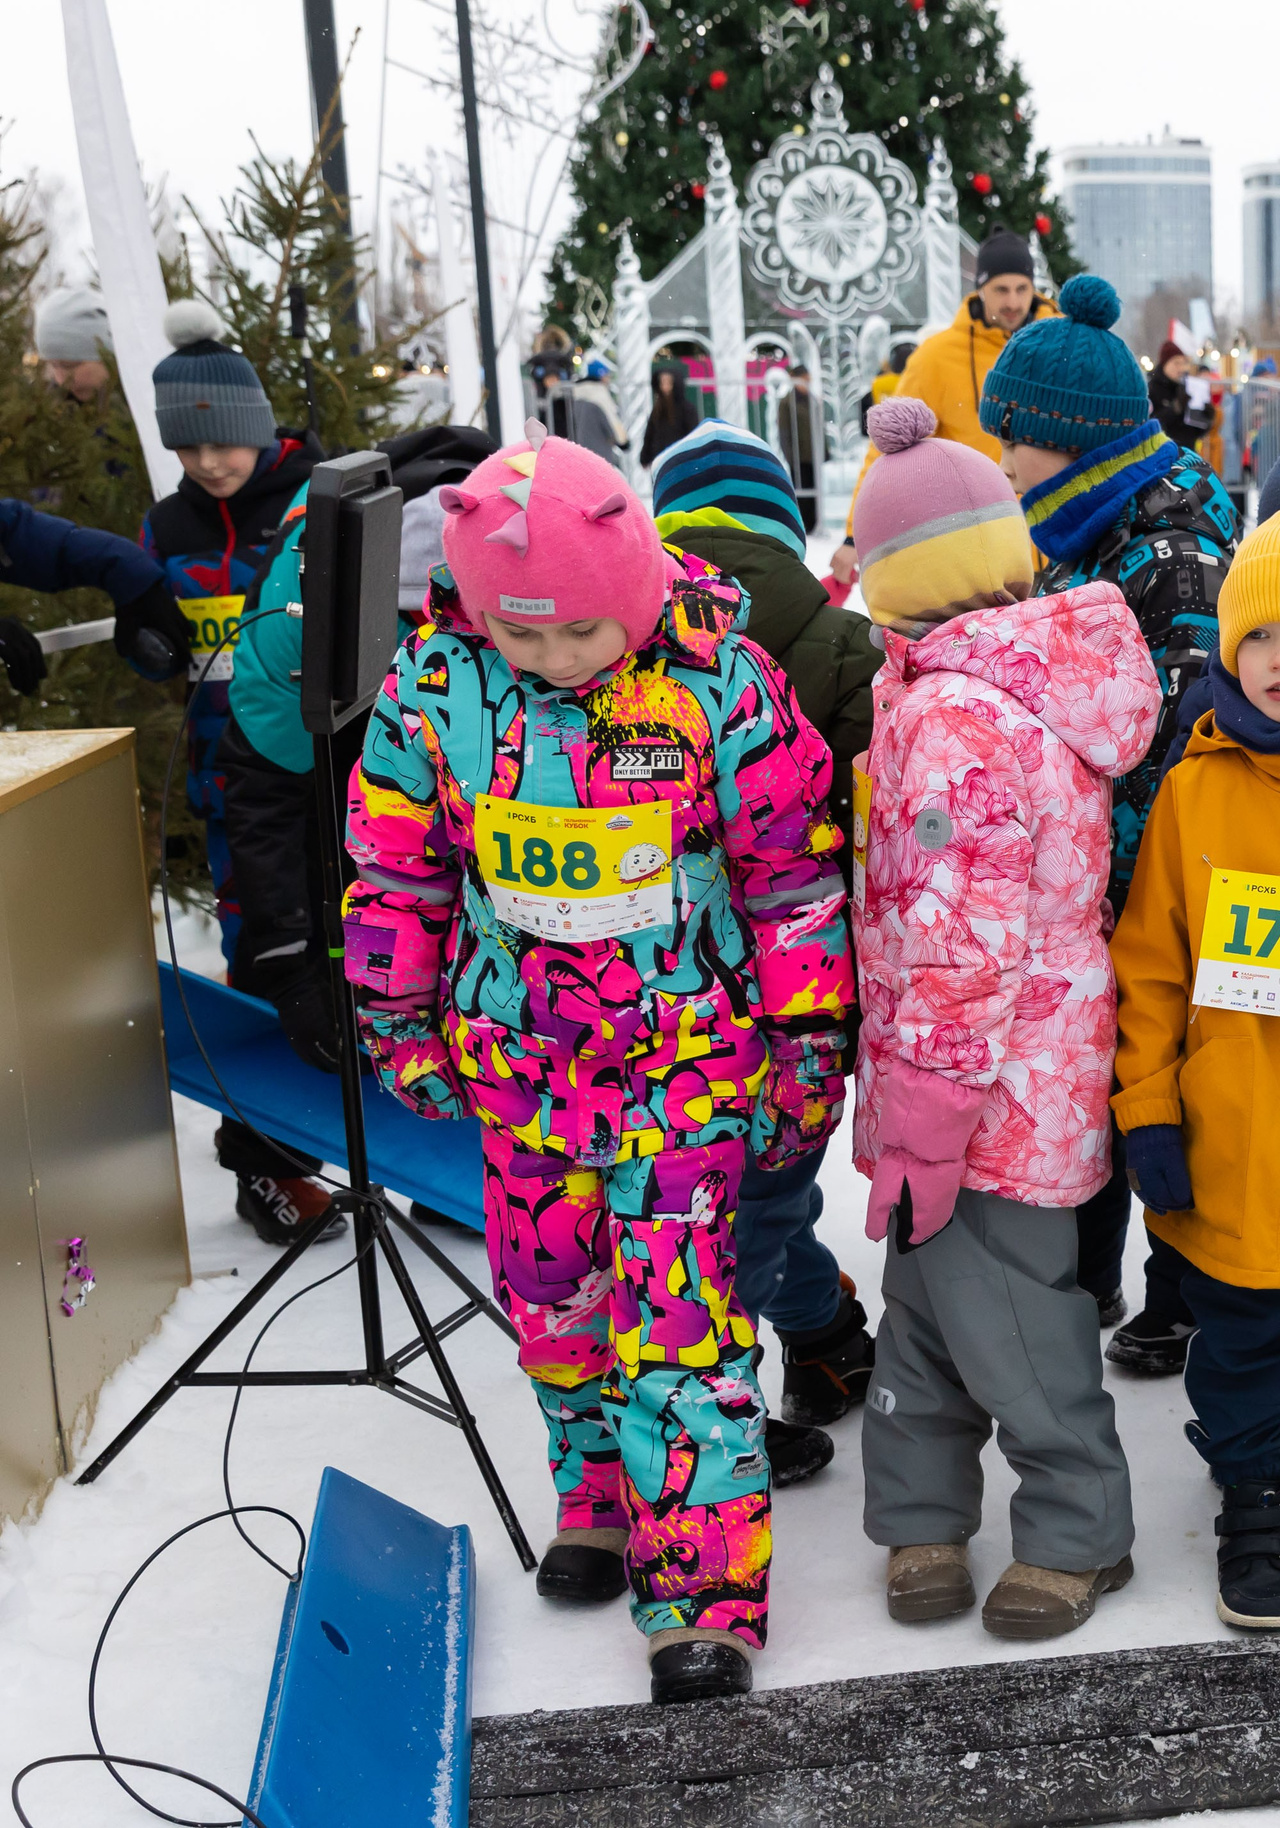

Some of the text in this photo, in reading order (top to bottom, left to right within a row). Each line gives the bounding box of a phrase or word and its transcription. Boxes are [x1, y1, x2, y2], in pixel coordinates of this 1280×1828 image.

[654, 754, 680, 768] PTD
[512, 812, 536, 824] РСХБ
[492, 830, 601, 890] 188
[1251, 885, 1277, 894] РСХБ
[250, 1175, 301, 1226] pine
